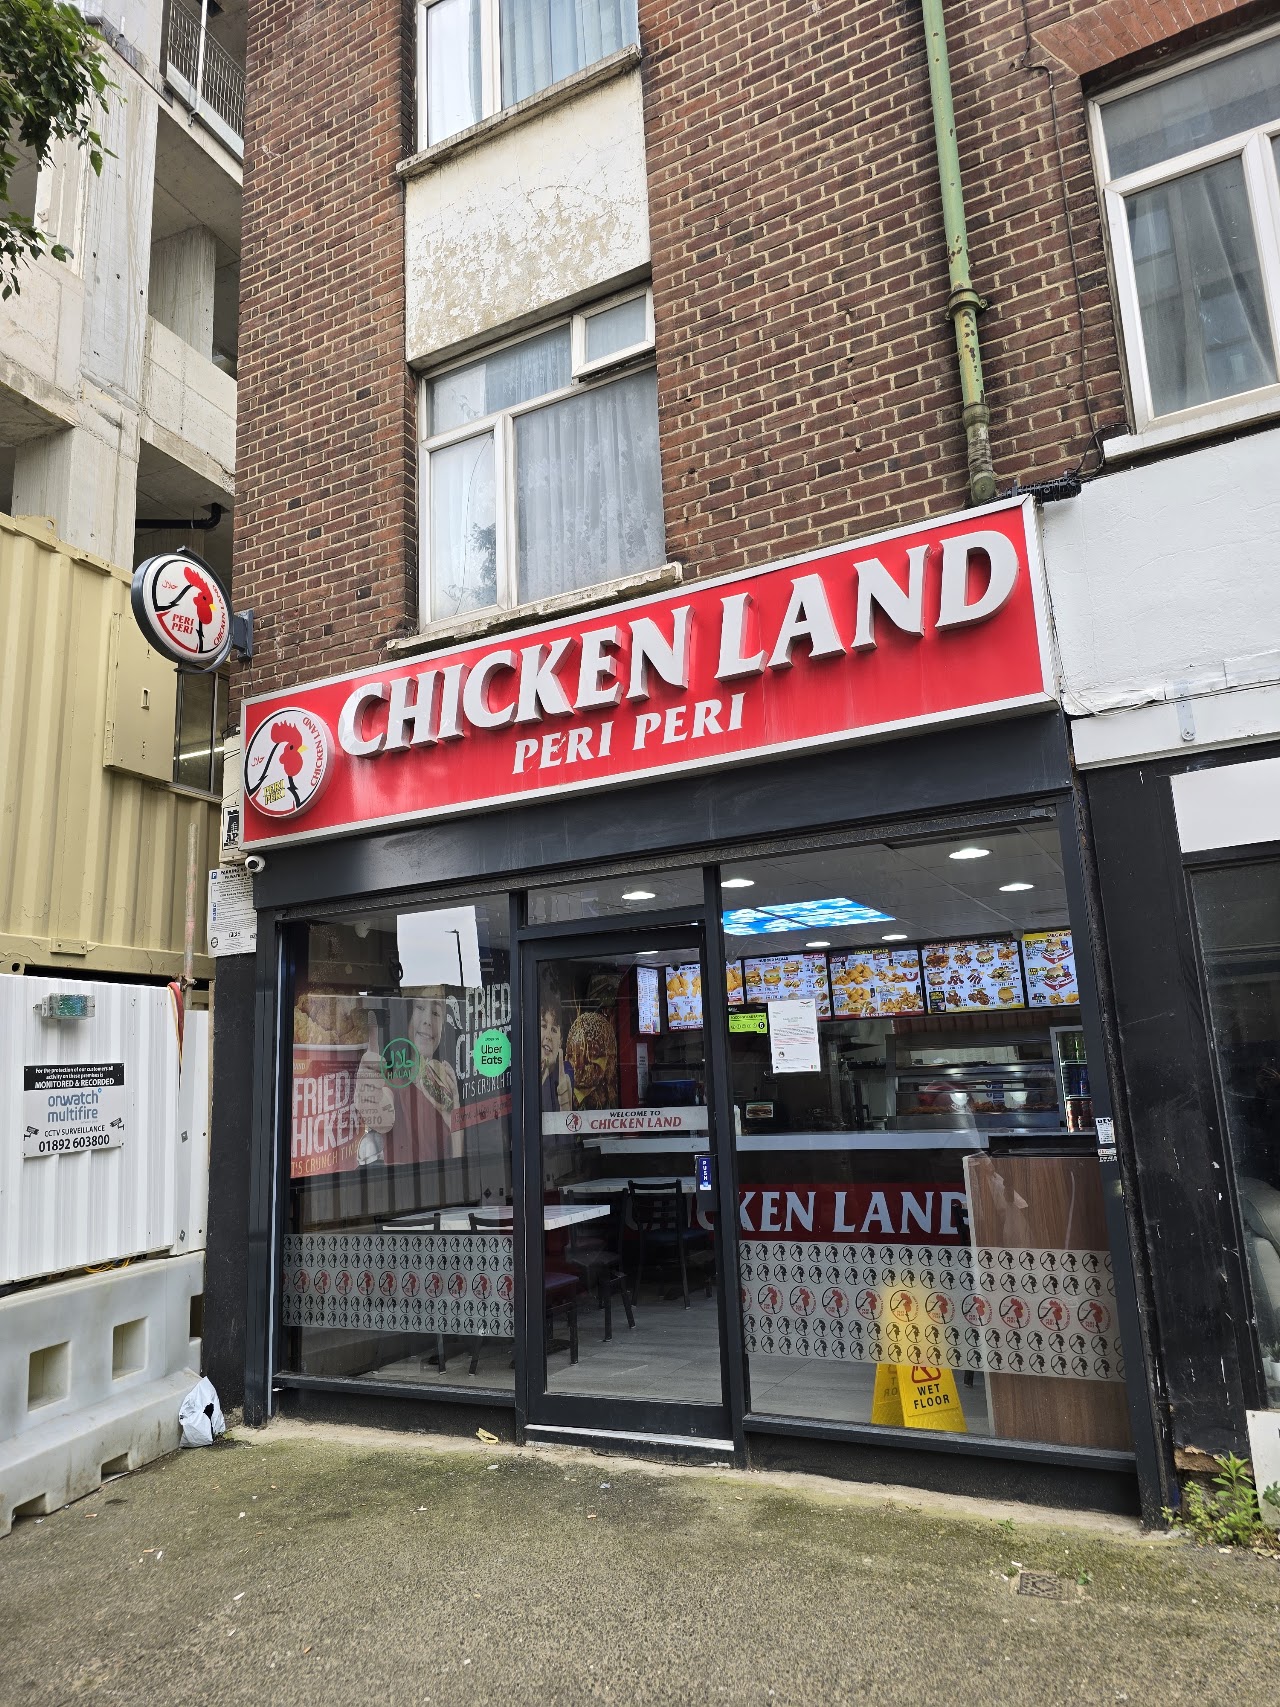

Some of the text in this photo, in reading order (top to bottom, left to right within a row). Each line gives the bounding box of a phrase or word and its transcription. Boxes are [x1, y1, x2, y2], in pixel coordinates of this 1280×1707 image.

[171, 613, 195, 627] PERI
[171, 622, 193, 635] PERI
[338, 530, 1020, 759] CHICKEN LAND
[512, 692, 747, 775] PERI PERI
[302, 716, 324, 787] CHICKEN LAND
[263, 778, 286, 796] PERI
[465, 982, 512, 1032] FRIED
[481, 1044, 503, 1055] Uber
[481, 1055, 503, 1065] Eats
[34, 1080, 74, 1089] MONITORED
[81, 1078, 114, 1087] RECORDED
[462, 1080, 476, 1100] IT'S
[48, 1089, 99, 1107] onwatch
[292, 1070, 352, 1118] FRIED
[47, 1106, 98, 1122] multifire
[44, 1125, 105, 1138] CCTV SURVEILLANCE
[590, 1116, 682, 1130] CHICKEN LAND
[39, 1134, 110, 1152] 01892 603800
[305, 1151, 338, 1173] CRUNCH
[917, 1383, 940, 1396] WET
[913, 1394, 950, 1410] FLOOR
